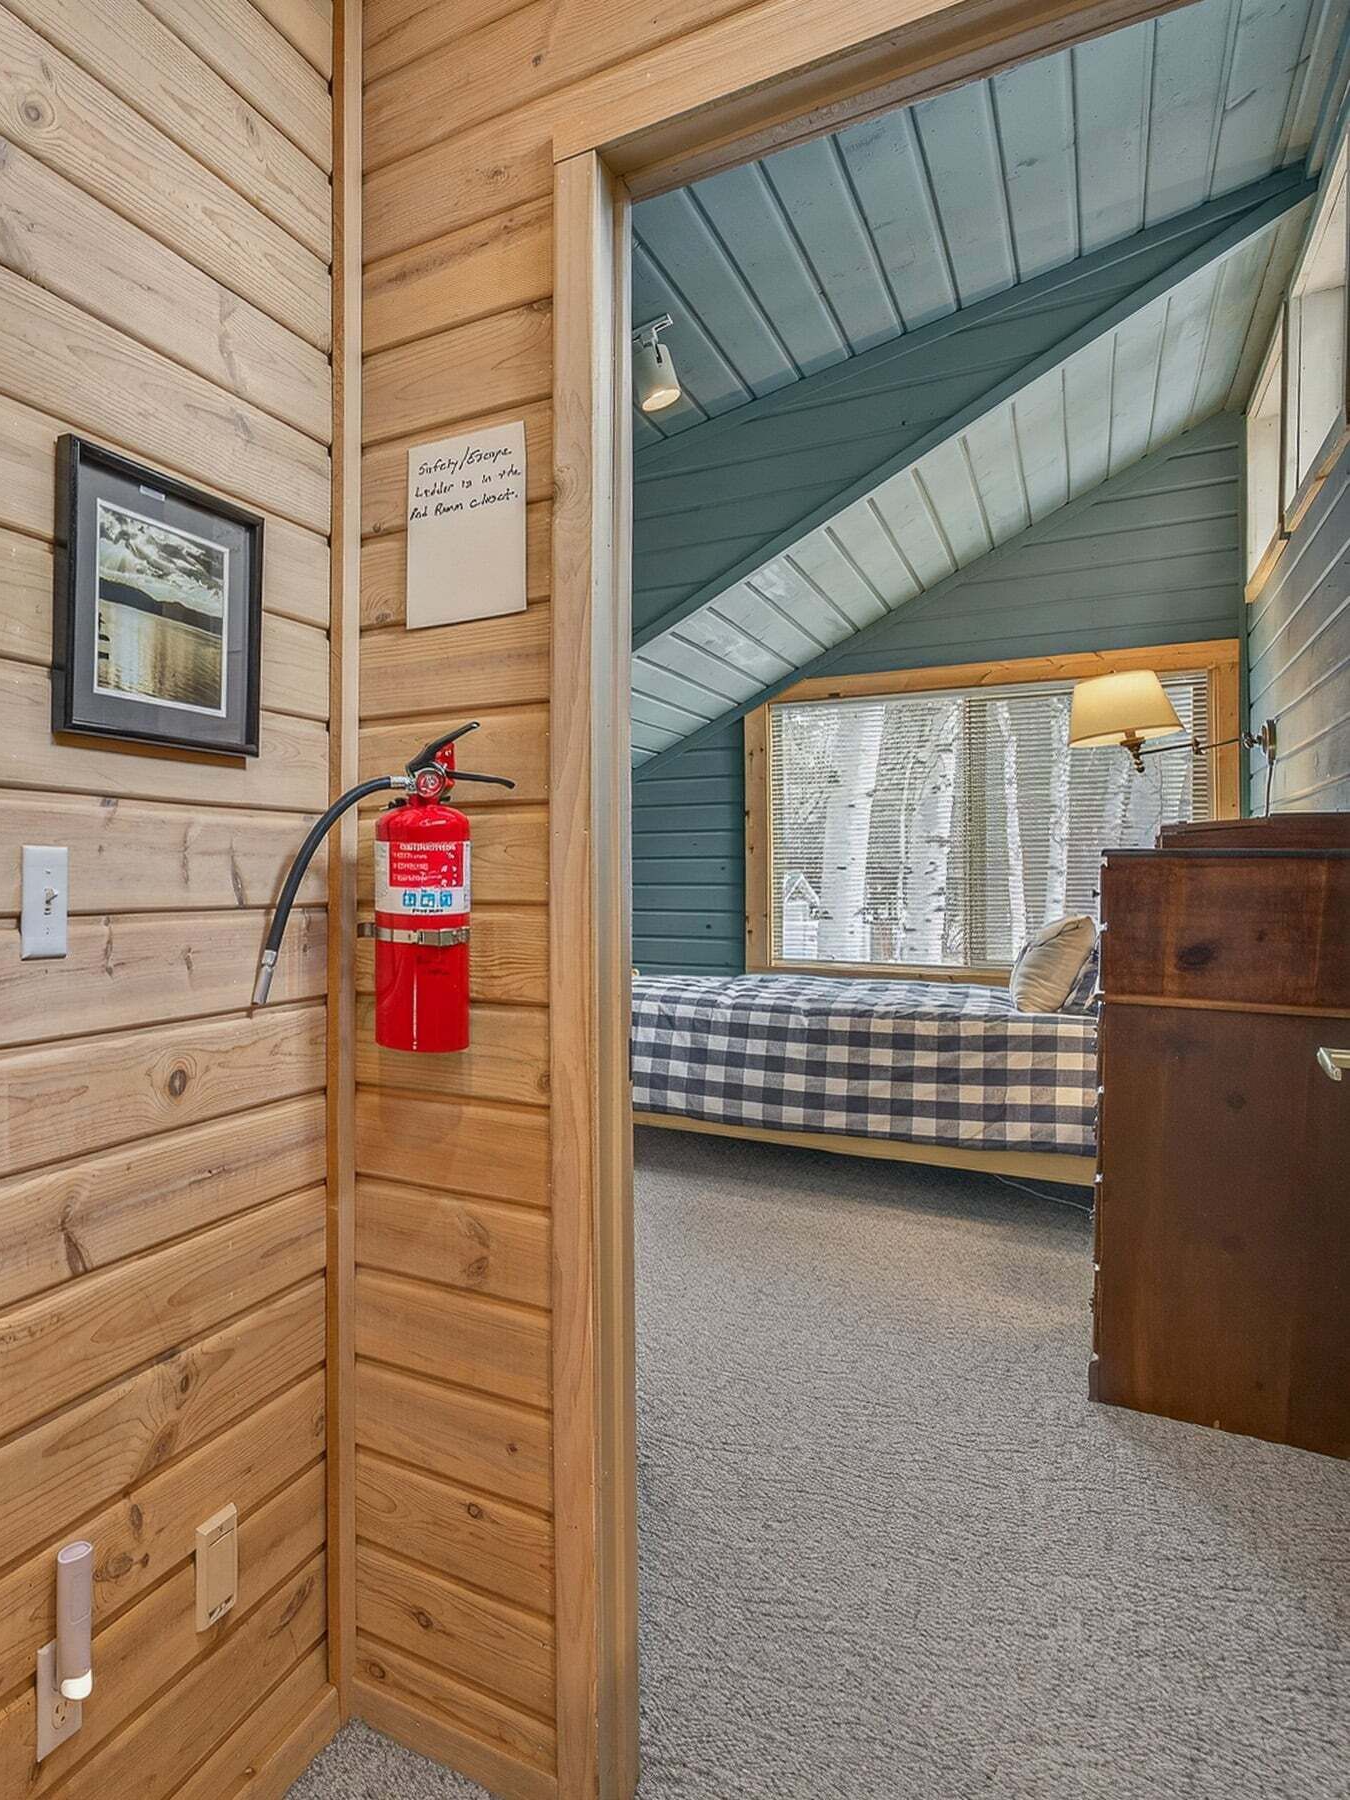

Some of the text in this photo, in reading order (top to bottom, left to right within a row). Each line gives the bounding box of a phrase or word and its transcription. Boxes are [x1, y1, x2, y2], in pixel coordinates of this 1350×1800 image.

[414, 481, 454, 498] Ladder
[461, 479, 473, 489] is
[481, 474, 492, 484] in
[433, 502, 464, 517] Room
